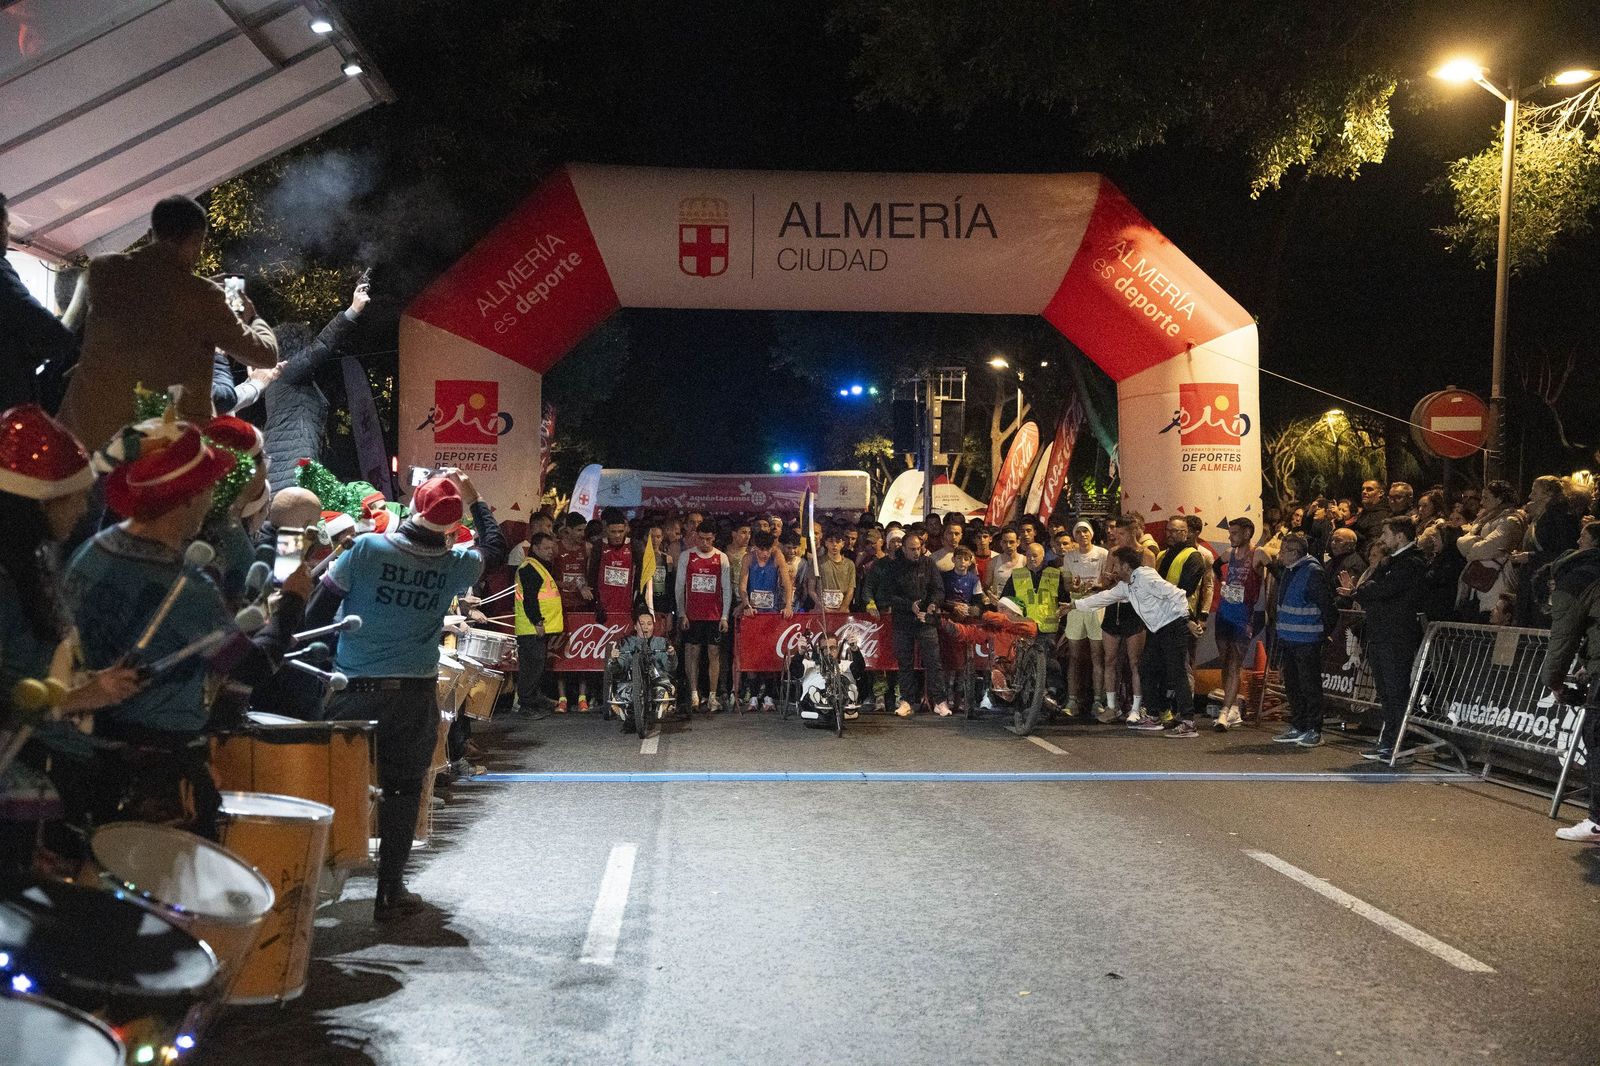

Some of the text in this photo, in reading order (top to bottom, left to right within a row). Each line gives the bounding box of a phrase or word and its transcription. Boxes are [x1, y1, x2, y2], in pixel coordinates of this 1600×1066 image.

[778, 195, 998, 239] ALMERÍA
[777, 247, 888, 273] CIUDAD
[477, 234, 566, 318] ALMERÍA
[1108, 240, 1195, 321] ALMERÍA
[494, 252, 583, 334] es deporte
[1092, 258, 1181, 337] es deporte
[434, 452, 498, 462] DEPORTES
[1182, 453, 1241, 462] DEPORTES
[1182, 463, 1242, 472] DE ALMERIA
[379, 563, 447, 589] BLOCO
[375, 585, 441, 611] SUCA
